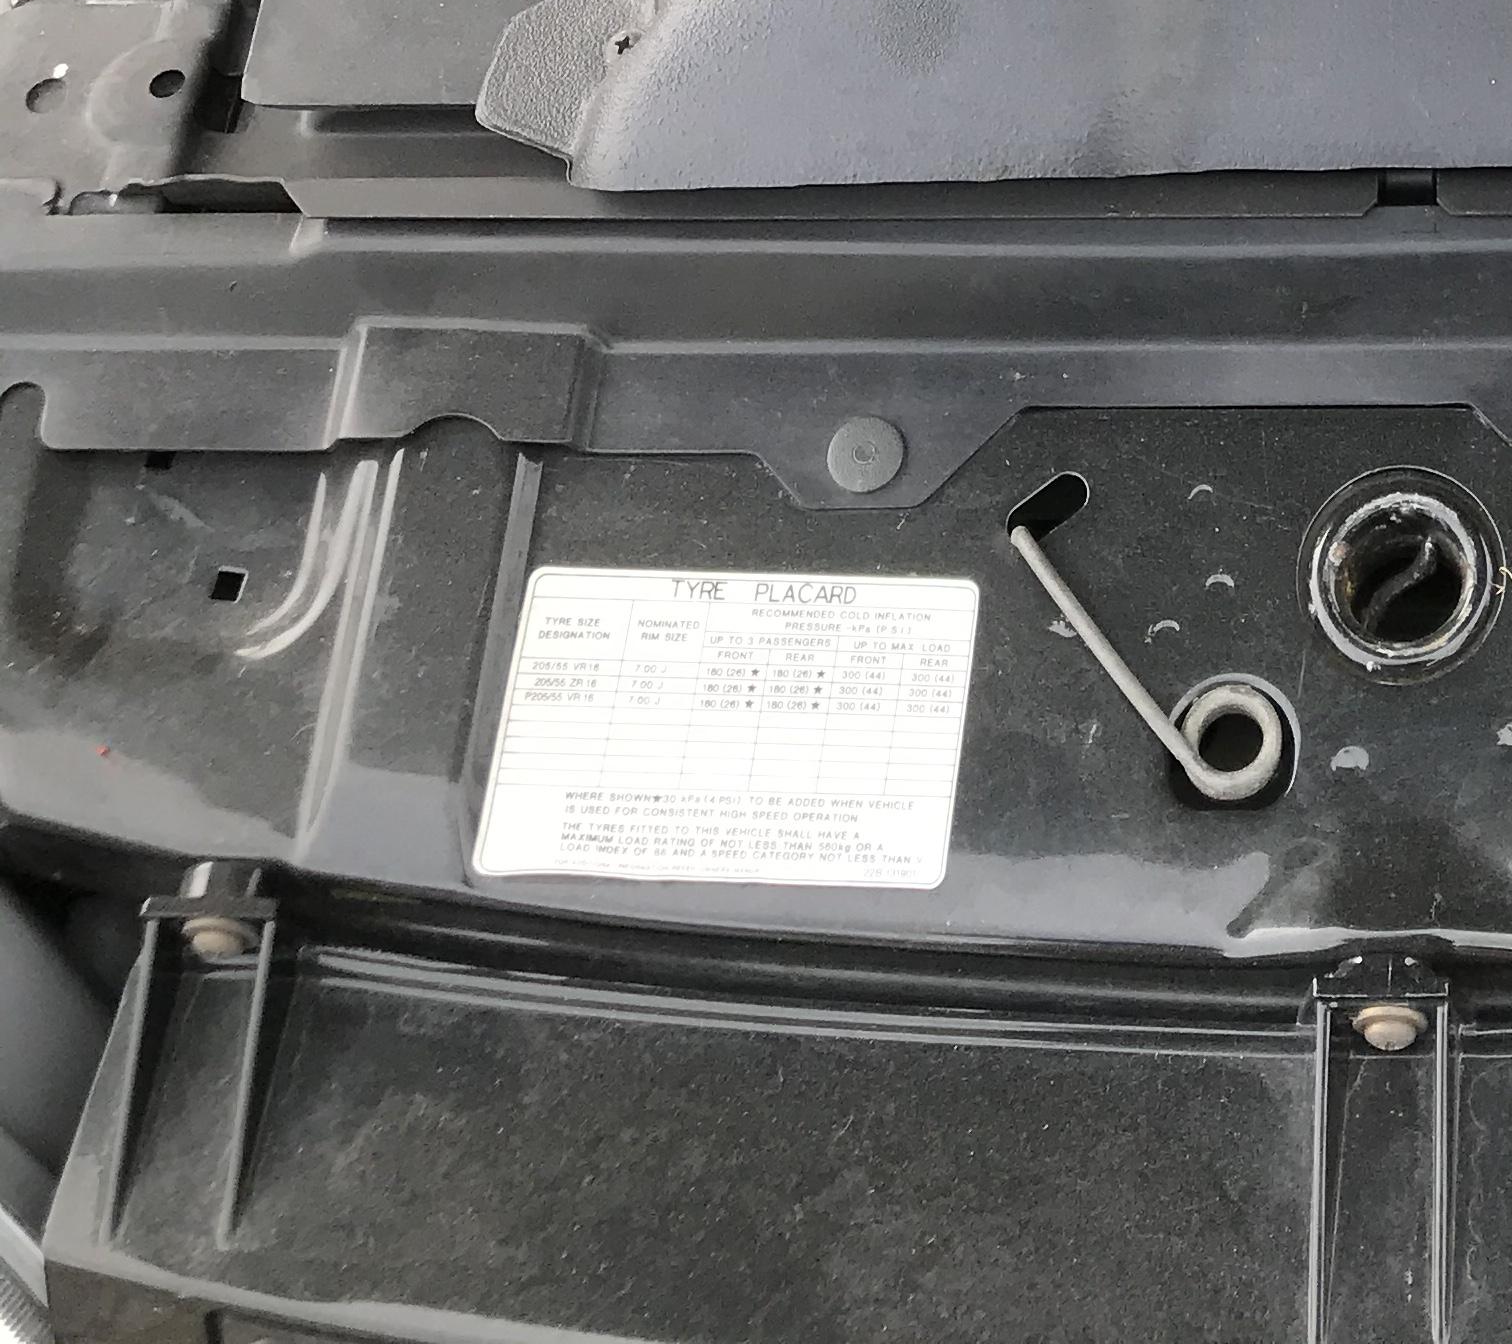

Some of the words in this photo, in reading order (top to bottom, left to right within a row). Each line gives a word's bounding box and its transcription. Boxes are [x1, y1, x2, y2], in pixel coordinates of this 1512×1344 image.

[668, 579, 728, 600] TYRE
[753, 582, 858, 604] PLACARD
[751, 608, 835, 618] RECOMMENDED
[839, 611, 870, 619] COLD
[544, 617, 572, 625] TYRE
[577, 618, 600, 626] SIZE
[637, 619, 700, 629] NOMINATED
[784, 622, 841, 631] PRESSURE
[538, 630, 610, 640] DESIGNATION
[640, 632, 660, 640] RIM
[665, 633, 688, 641] SIZE
[709, 635, 723, 643] UP
[729, 636, 743, 644] TO
[758, 637, 831, 647] PASSENGERS
[853, 642, 867, 650] UP
[872, 642, 887, 650] TO
[921, 644, 951, 652] LOAD
[717, 651, 753, 659] FRONT
[850, 655, 886, 664] FRONT
[919, 658, 948, 666] REAR
[841, 671, 860, 679] 300
[865, 671, 885, 680] (44)
[911, 673, 930, 682] 300
[934, 674, 954, 683] (44)
[565, 805, 575, 814] IS
[580, 806, 610, 815] USED
[614, 806, 638, 815] FOR
[642, 807, 714, 817] CONSISTENT
[719, 809, 746, 818] HIGH
[752, 810, 788, 819] SPEED
[561, 823, 582, 832] THE
[588, 823, 624, 833] TYRES
[629, 824, 668, 834] FITTED
[674, 826, 689, 835] TO
[694, 826, 719, 835] THIS
[725, 827, 771, 837] VEHICLE
[777, 828, 812, 838] SHALL
[818, 829, 848, 839] HAVE
[853, 830, 860, 839] A
